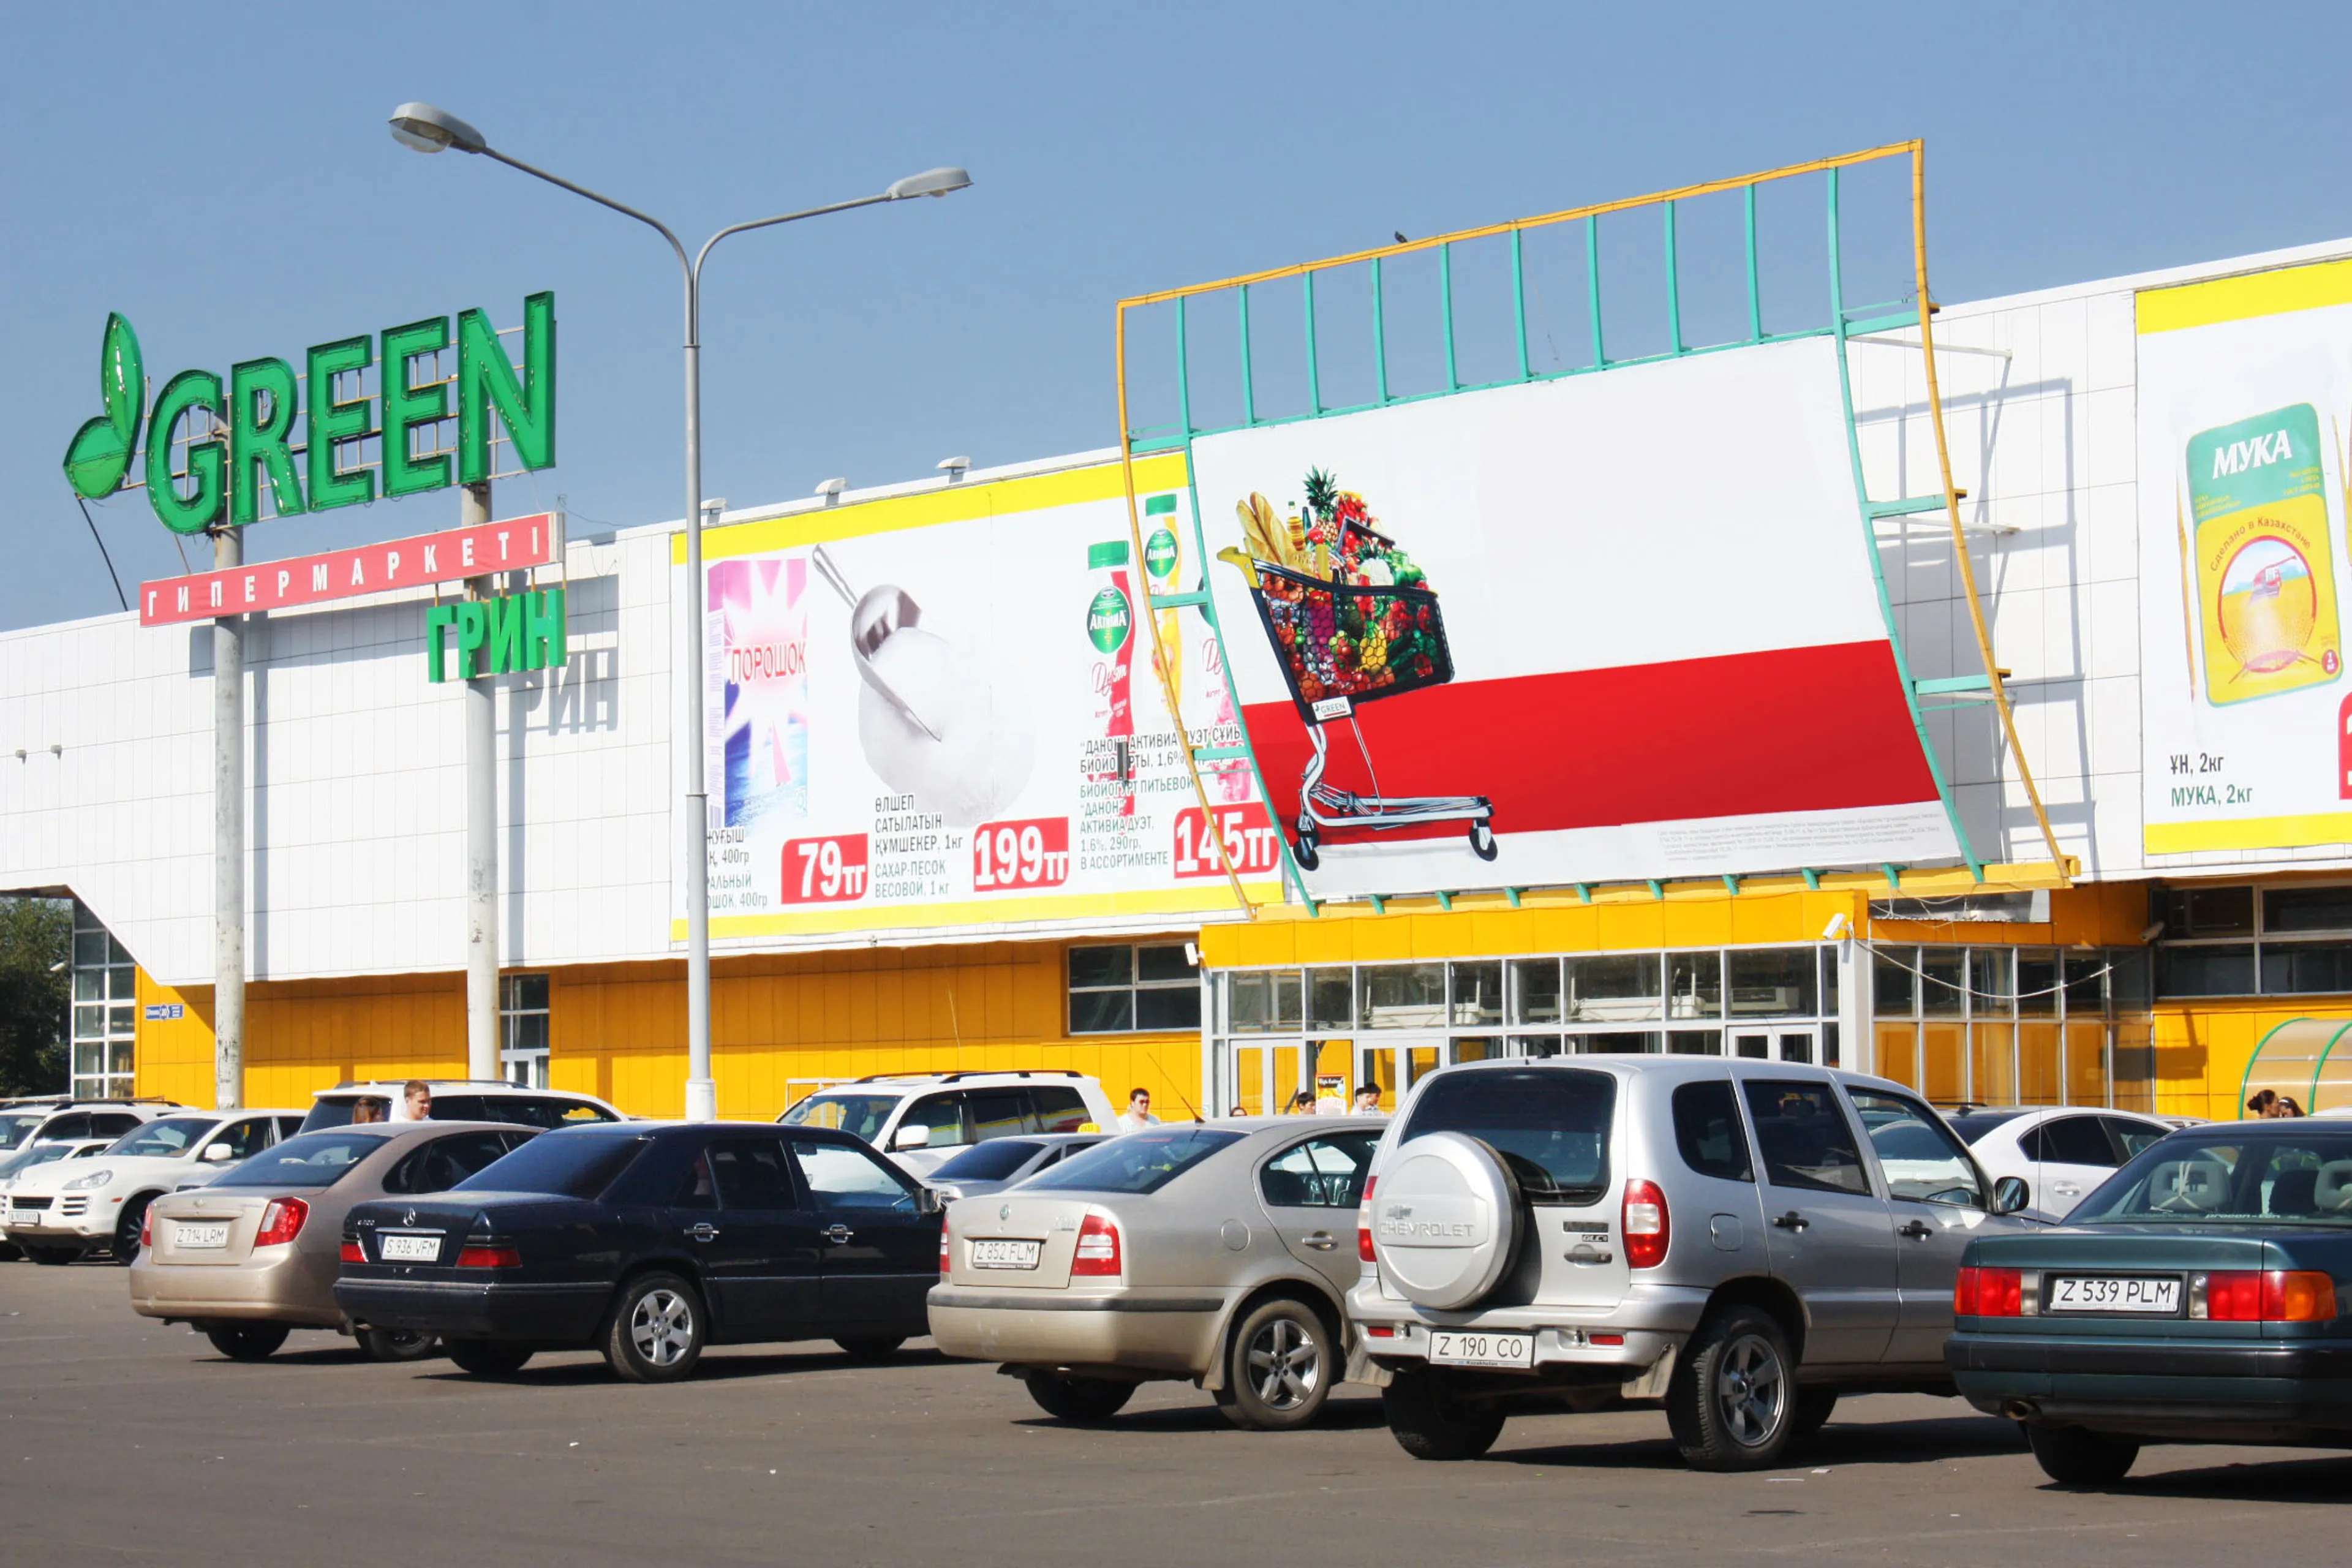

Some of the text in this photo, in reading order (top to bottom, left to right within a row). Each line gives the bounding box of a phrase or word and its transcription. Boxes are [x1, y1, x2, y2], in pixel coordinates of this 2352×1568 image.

[145, 291, 555, 535] GREEN
[2212, 429, 2292, 480] МУКА
[2210, 516, 2311, 571] Сделано в Казахстане
[148, 526, 540, 617] ГИПЕРМАРКЕТІ
[427, 589, 567, 683] ГРИН
[731, 642, 807, 682] ПОРОШОК
[1321, 703, 1346, 714] GREEN
[1129, 735, 1177, 748] АКТИВИА
[1185, 729, 1209, 744] УЭТ
[2199, 753, 2224, 773] 2кг
[875, 795, 914, 812] ӨЛШЕП
[2171, 784, 2253, 809] МУКА, 2кг
[875, 813, 942, 833] САТЫЛАТЫН
[1080, 816, 1154, 834] АКТИВИА ДУЭТ,
[875, 860, 946, 878] САХАР-ПЕСОК
[1081, 851, 1169, 870] В АССОРТИМЕНТЕ
[875, 877, 926, 898] ВЕСОВОЙ,
[177, 1229, 224, 1243] Z 714 LRM
[1379, 1221, 1474, 1237] CHEVROLET
[386, 1239, 436, 1254] S 936 VFM
[977, 1243, 1035, 1261] Z 852 FLM
[2061, 1281, 2171, 1303] Z 539 PLM
[1439, 1336, 1523, 1358] Z 190 CO
